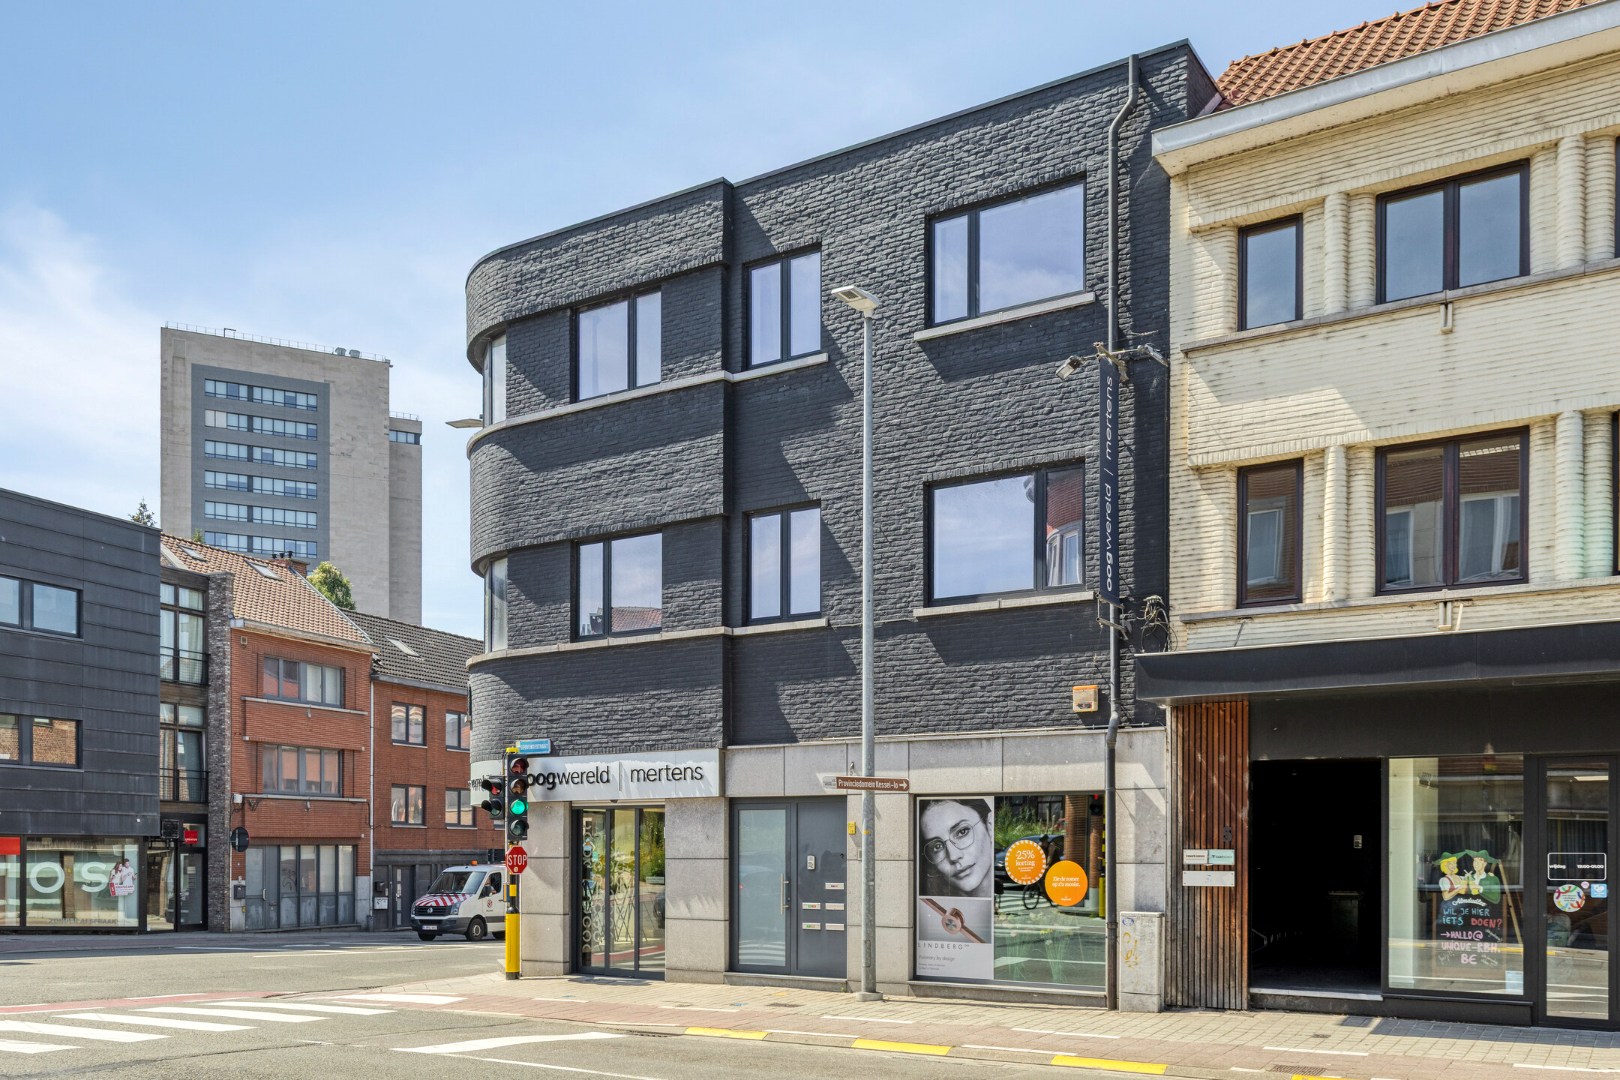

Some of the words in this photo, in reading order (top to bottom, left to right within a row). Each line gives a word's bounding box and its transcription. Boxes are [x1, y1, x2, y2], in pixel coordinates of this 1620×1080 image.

[1104, 483, 1113, 591] oogwereld
[527, 766, 610, 790] oogwereld
[630, 766, 704, 783] mertens
[508, 854, 527, 866] STOP
[1016, 850, 1035, 860] 25%
[1460, 907, 1469, 915] JE
[1471, 917, 1502, 930] DOEN?
[1450, 930, 1483, 941] HALLO@
[917, 942, 963, 950] LINDBERG
[1460, 953, 1477, 965] BE
